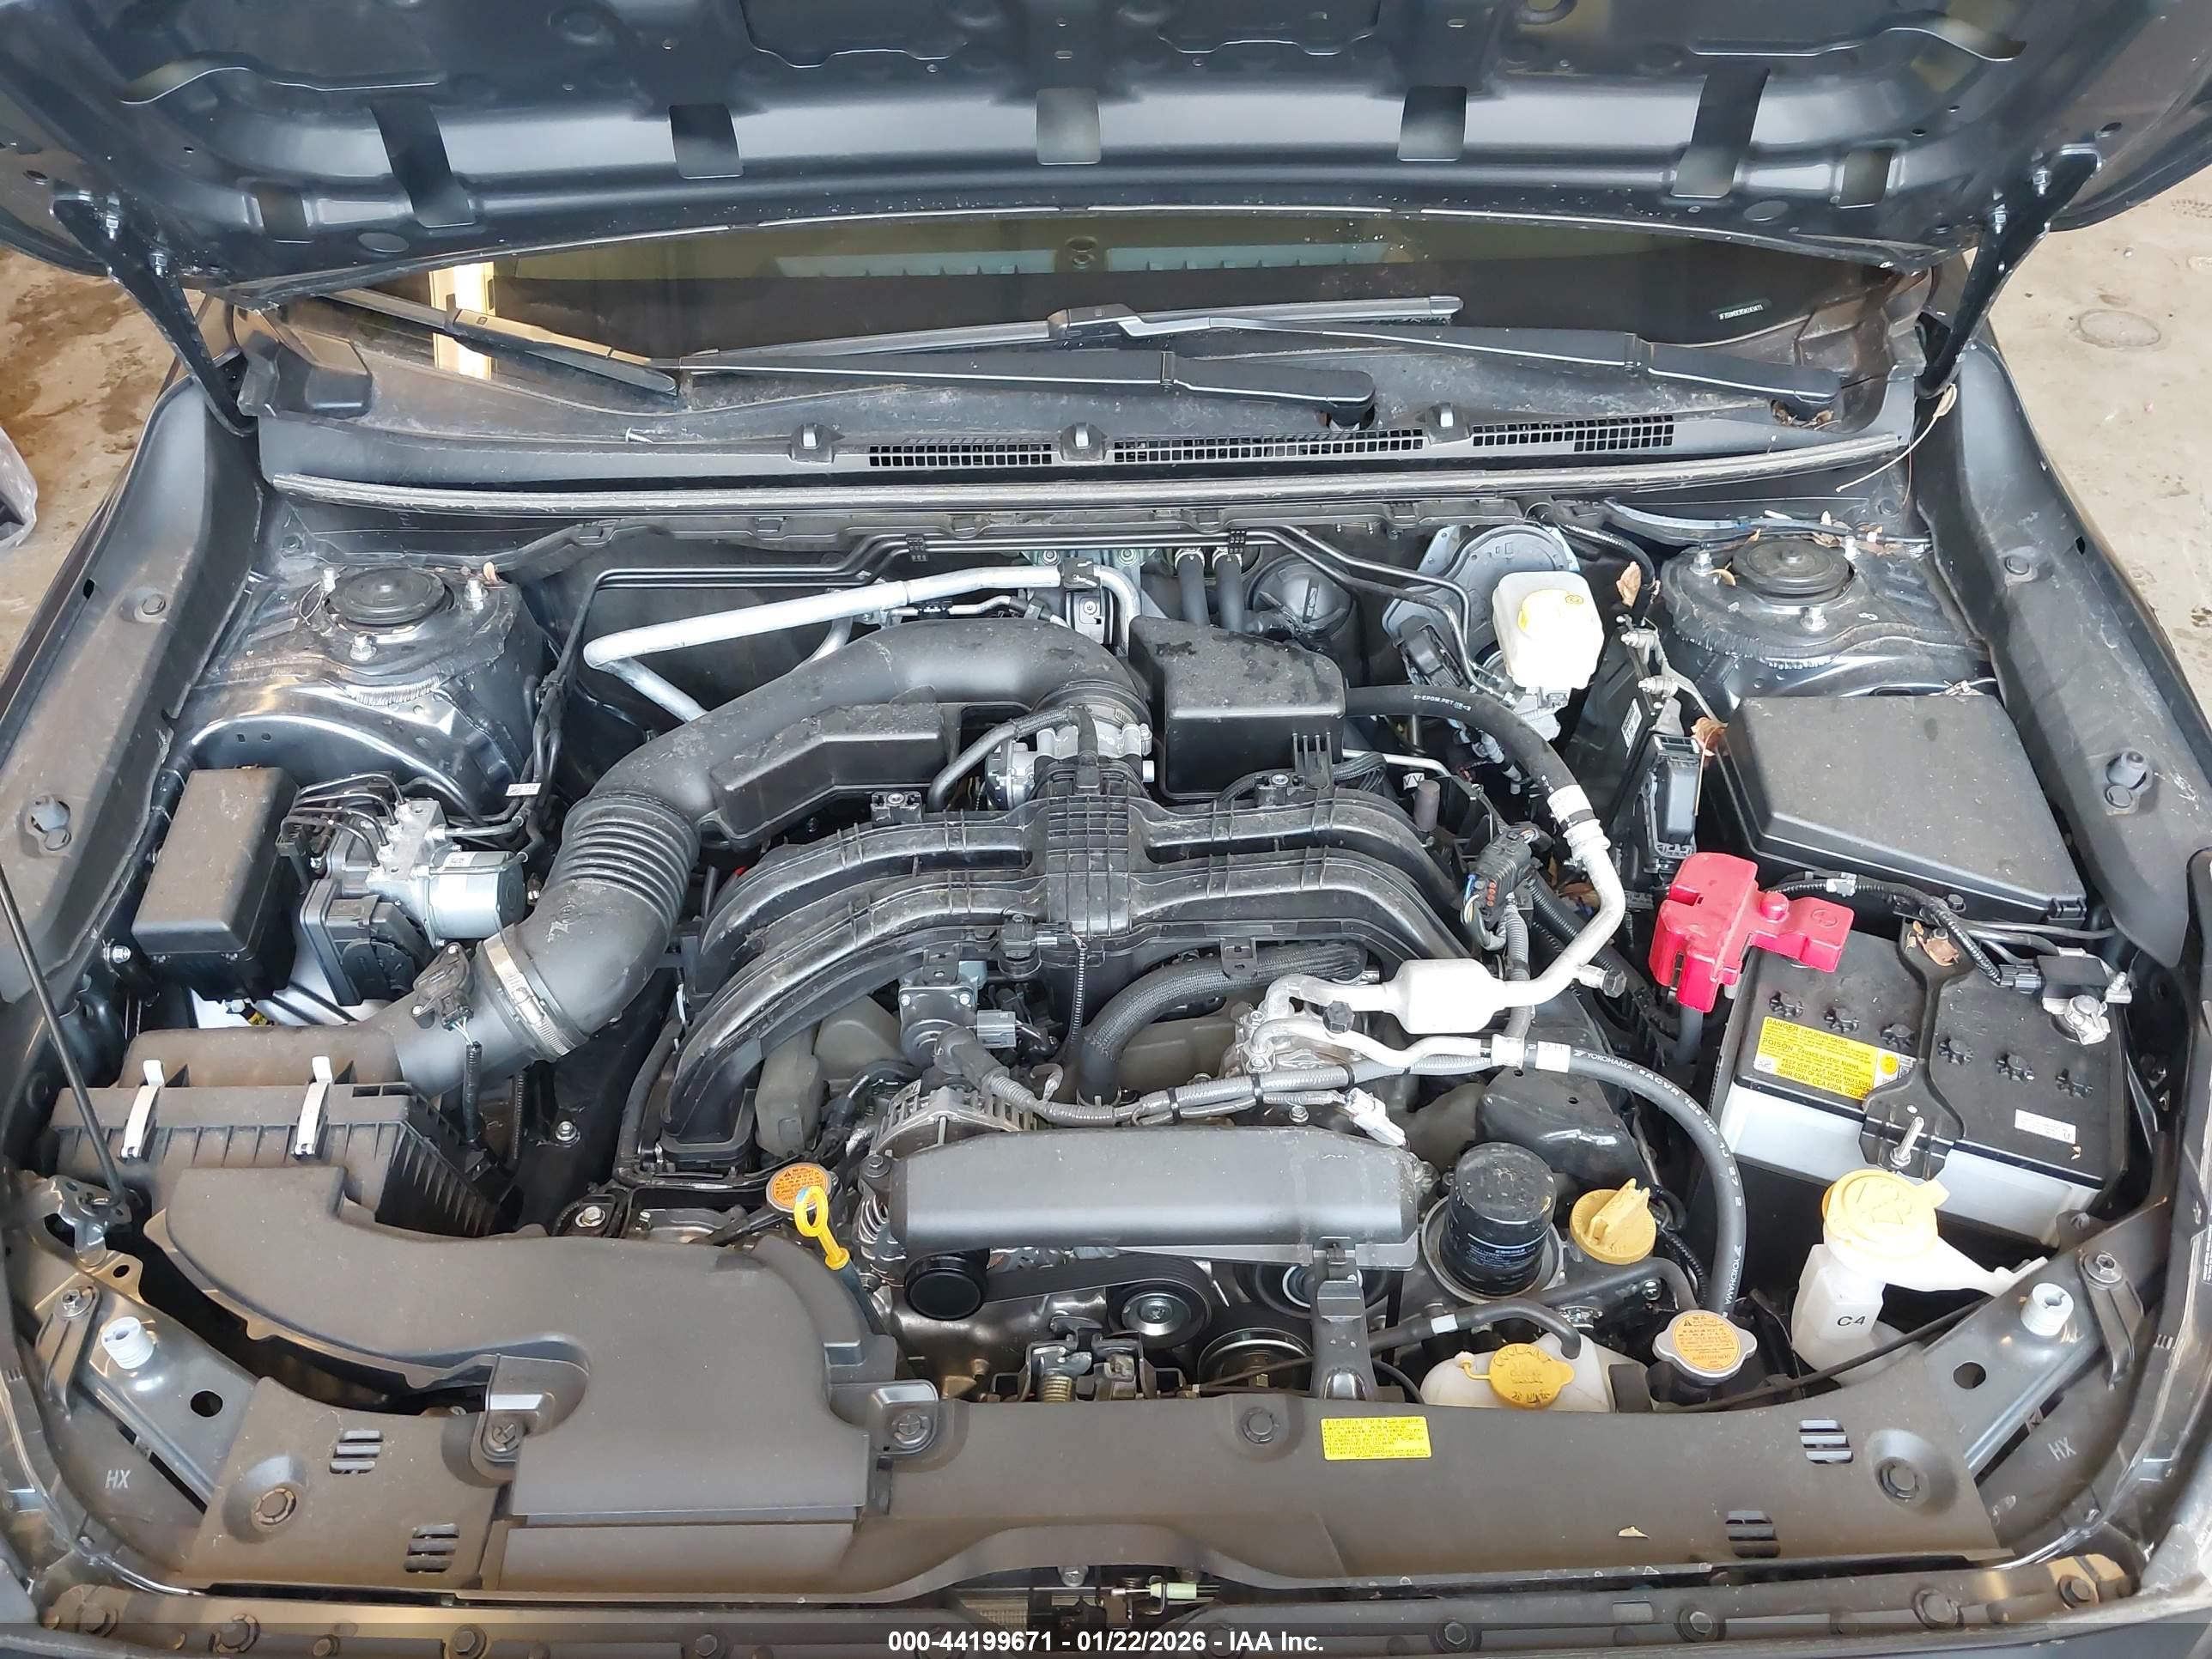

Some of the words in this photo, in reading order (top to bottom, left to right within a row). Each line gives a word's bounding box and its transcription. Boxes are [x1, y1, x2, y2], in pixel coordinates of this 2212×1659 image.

[1766, 1018, 1799, 1031] DANGER
[1762, 1037, 1794, 1051] POISON
[1587, 1052, 1633, 1071] YOKOHAMA
[1812, 1078, 1826, 1086] CCA
[1843, 1074, 1854, 1083] AND
[1724, 1258, 1741, 1306] YOKOHAMA
[1837, 1315, 1866, 1327] C4
[2047, 1436, 2077, 1462] HX
[104, 1468, 131, 1489] HX
